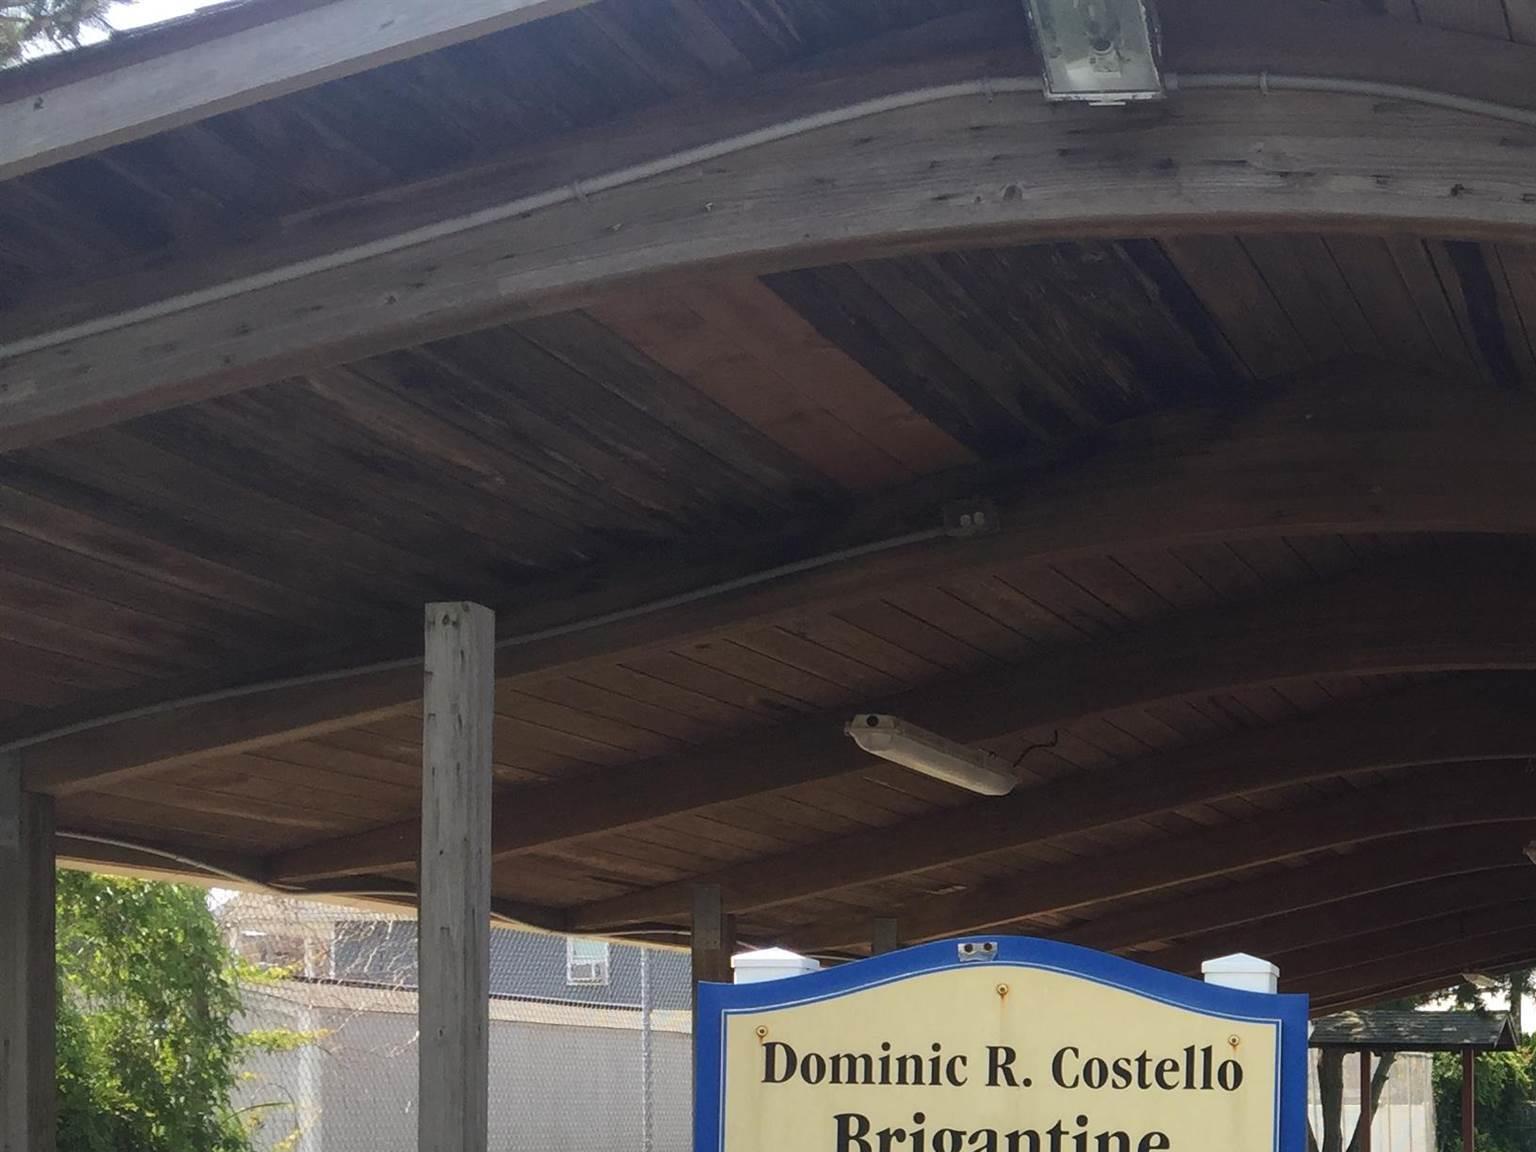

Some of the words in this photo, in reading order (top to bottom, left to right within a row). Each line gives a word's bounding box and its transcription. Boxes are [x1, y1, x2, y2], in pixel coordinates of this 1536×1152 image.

[761, 1041, 967, 1086] Dominic
[985, 1045, 1033, 1088] R.
[1051, 1045, 1244, 1093] Costello
